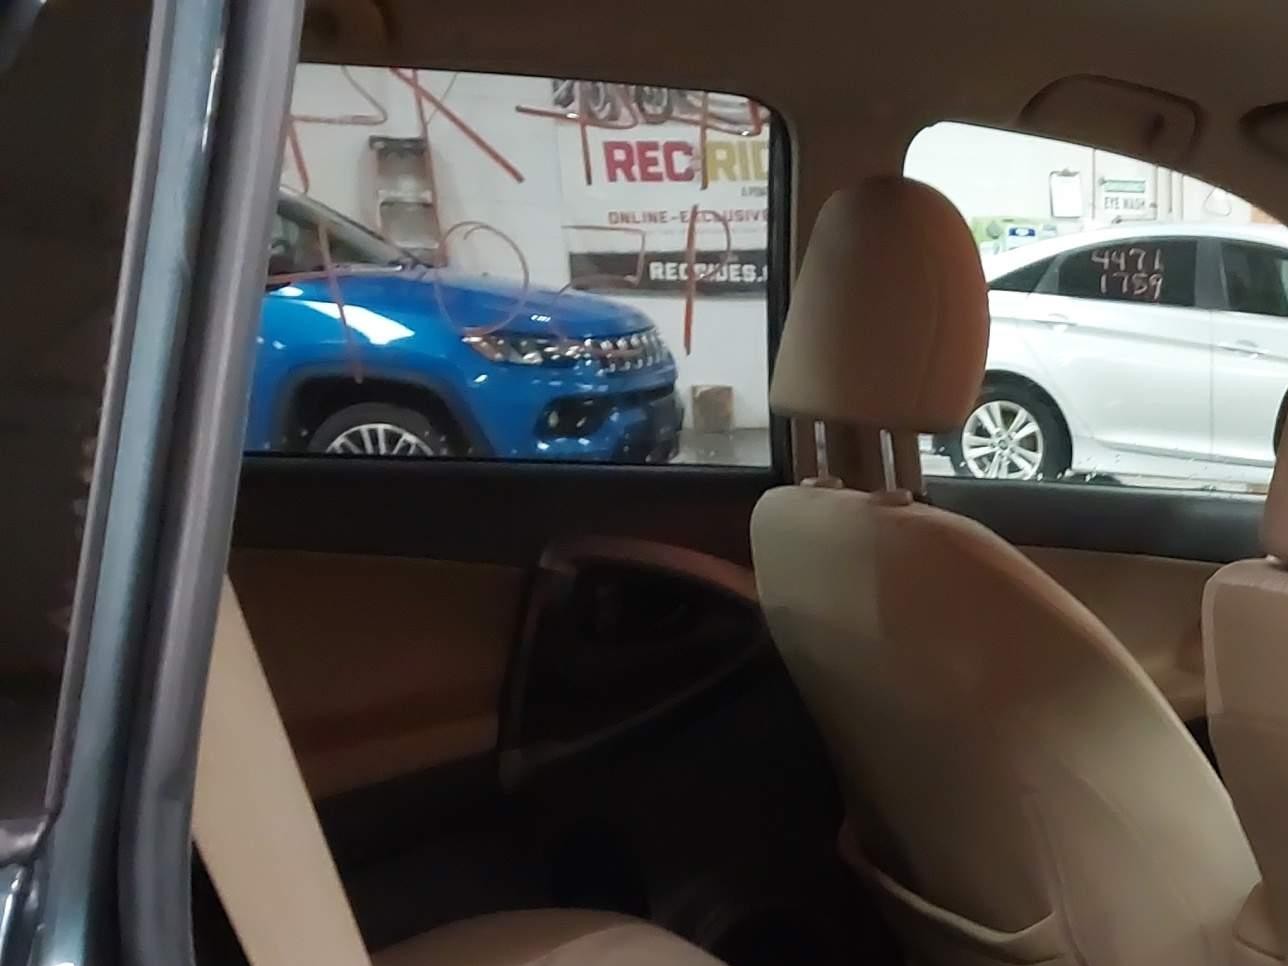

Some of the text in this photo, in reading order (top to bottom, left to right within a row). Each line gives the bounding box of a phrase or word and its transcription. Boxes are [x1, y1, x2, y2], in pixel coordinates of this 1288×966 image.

[603, 141, 695, 182] REC
[1104, 196, 1120, 210] EYE
[1091, 247, 1164, 271] 4471
